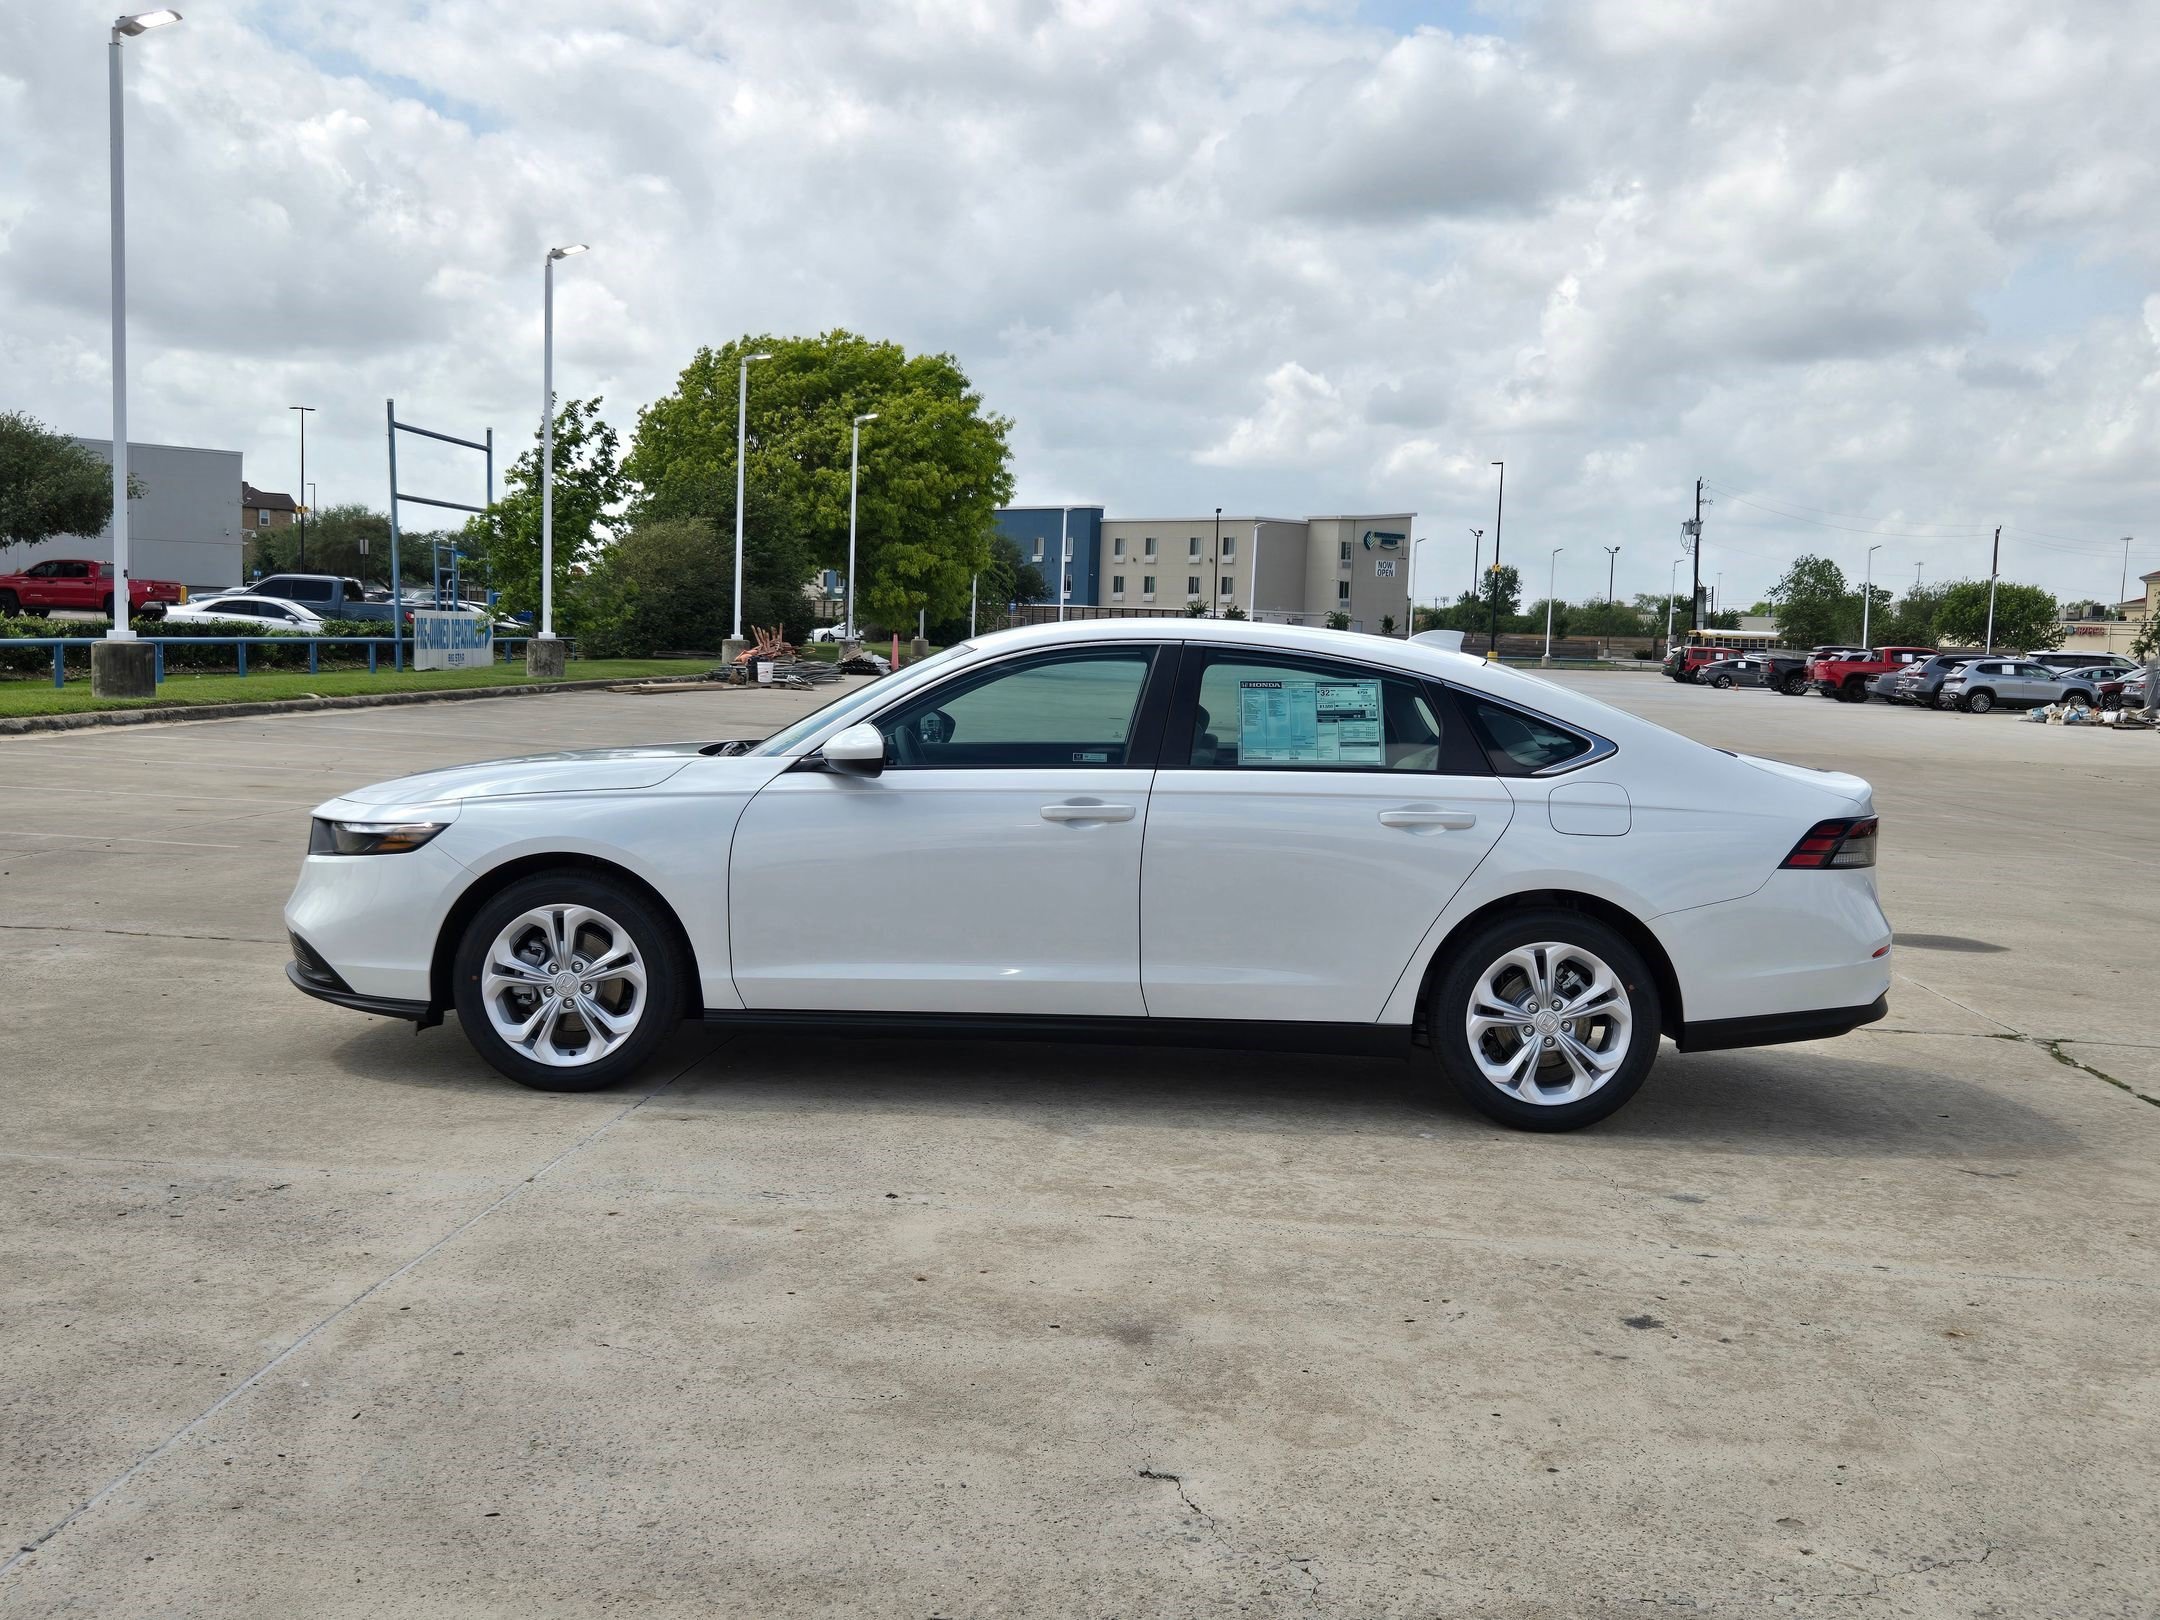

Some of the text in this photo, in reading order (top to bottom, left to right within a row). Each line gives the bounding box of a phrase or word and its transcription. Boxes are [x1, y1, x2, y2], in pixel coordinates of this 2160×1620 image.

[1378, 561, 1394, 569] NOW
[1377, 569, 1394, 577] OPEN
[1320, 689, 1330, 697] 32
